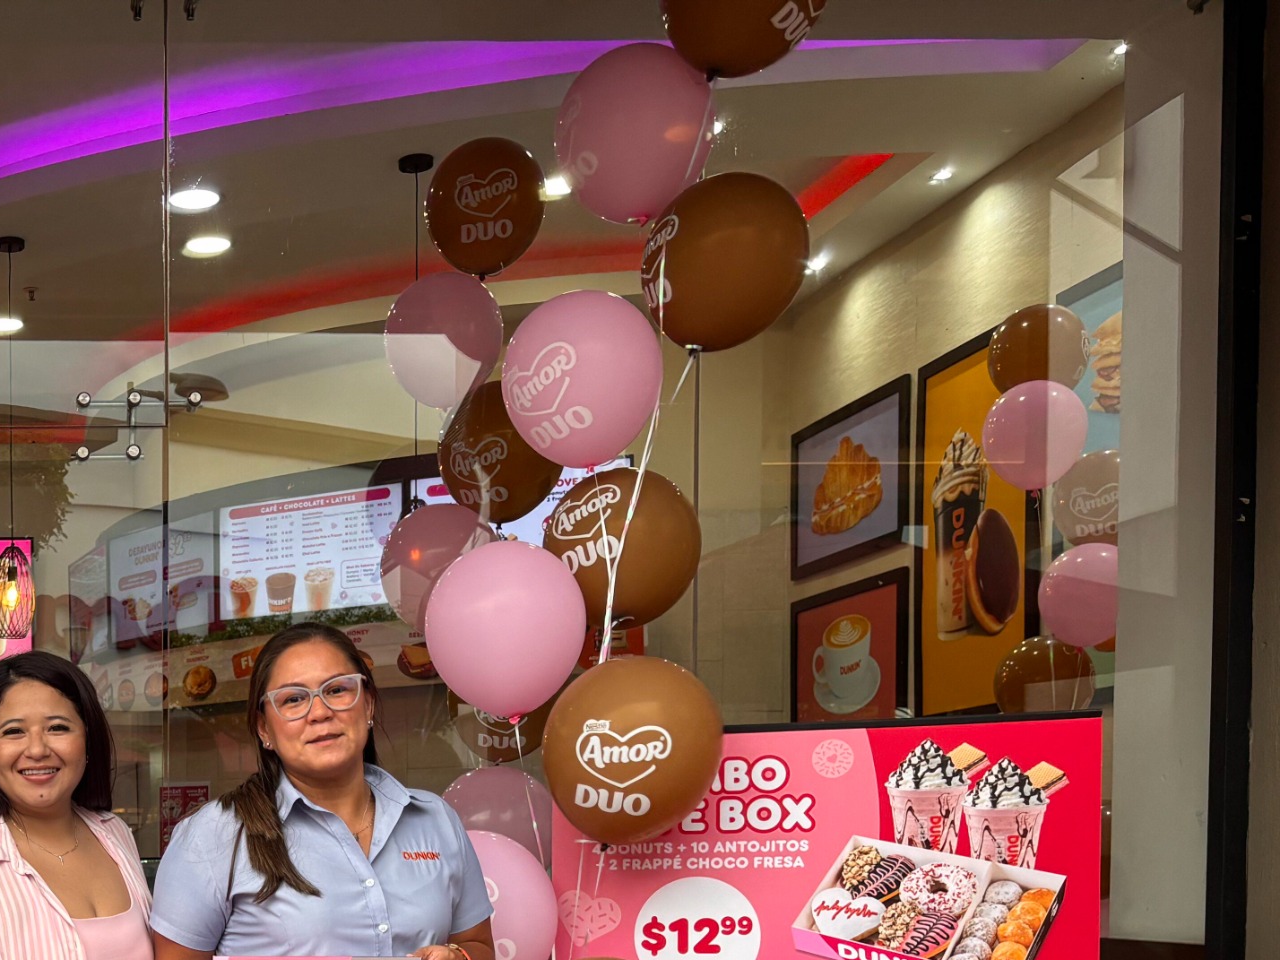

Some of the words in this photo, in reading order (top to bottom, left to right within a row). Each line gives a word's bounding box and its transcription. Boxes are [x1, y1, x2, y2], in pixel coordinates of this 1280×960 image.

[461, 218, 514, 244] DUO
[643, 277, 673, 309] UO
[530, 405, 594, 449] DUO
[260, 505, 278, 514] CAFÉ
[283, 498, 325, 511] CHOCOLATE
[330, 494, 356, 504] LATTES
[562, 535, 620, 576] DUO
[839, 659, 862, 675] DUNKIN'
[477, 733, 527, 749] DUO
[711, 757, 788, 792] BO
[575, 783, 652, 817] DUO
[718, 795, 814, 832] BOX
[606, 842, 673, 855] DONUTS
[690, 841, 710, 854] 10
[713, 839, 810, 853] ANTOJITOS
[609, 859, 618, 870] 2
[622, 854, 683, 870] FRAPPÉ
[686, 856, 749, 869] CHOCO
[753, 855, 805, 868] FRESA
